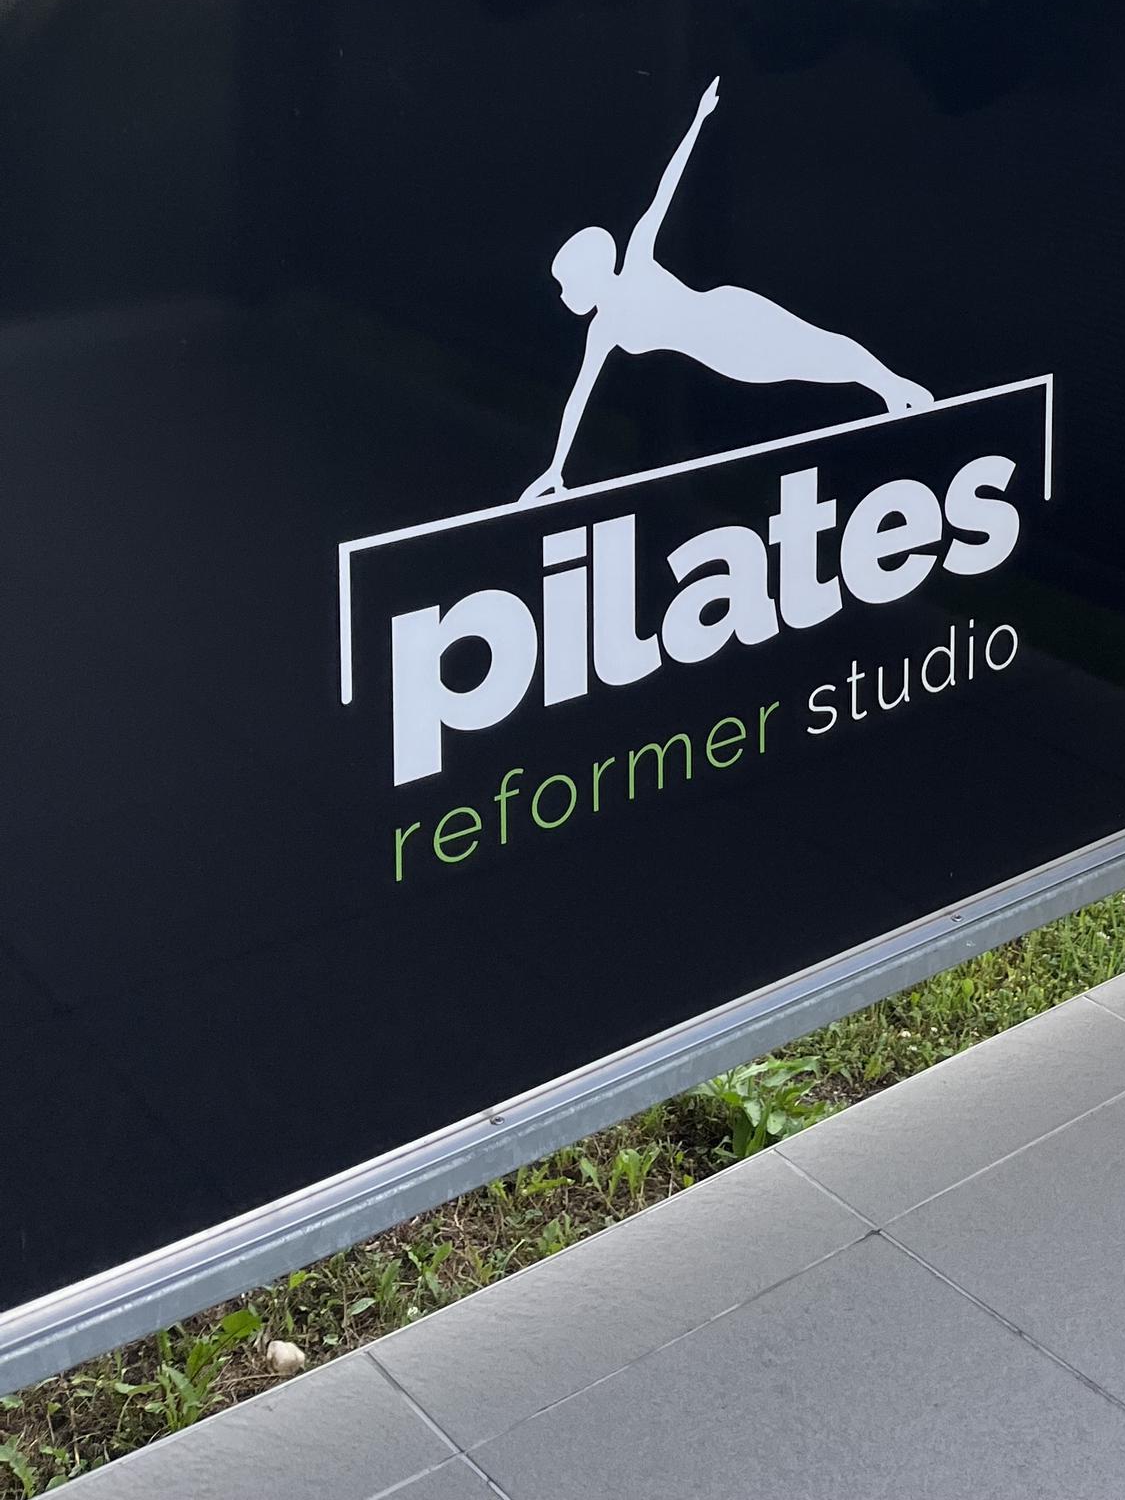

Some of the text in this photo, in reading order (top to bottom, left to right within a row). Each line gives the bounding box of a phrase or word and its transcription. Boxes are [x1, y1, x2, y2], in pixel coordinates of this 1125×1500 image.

[391, 455, 1020, 786] pilates
[394, 619, 1019, 881] reformer studio
